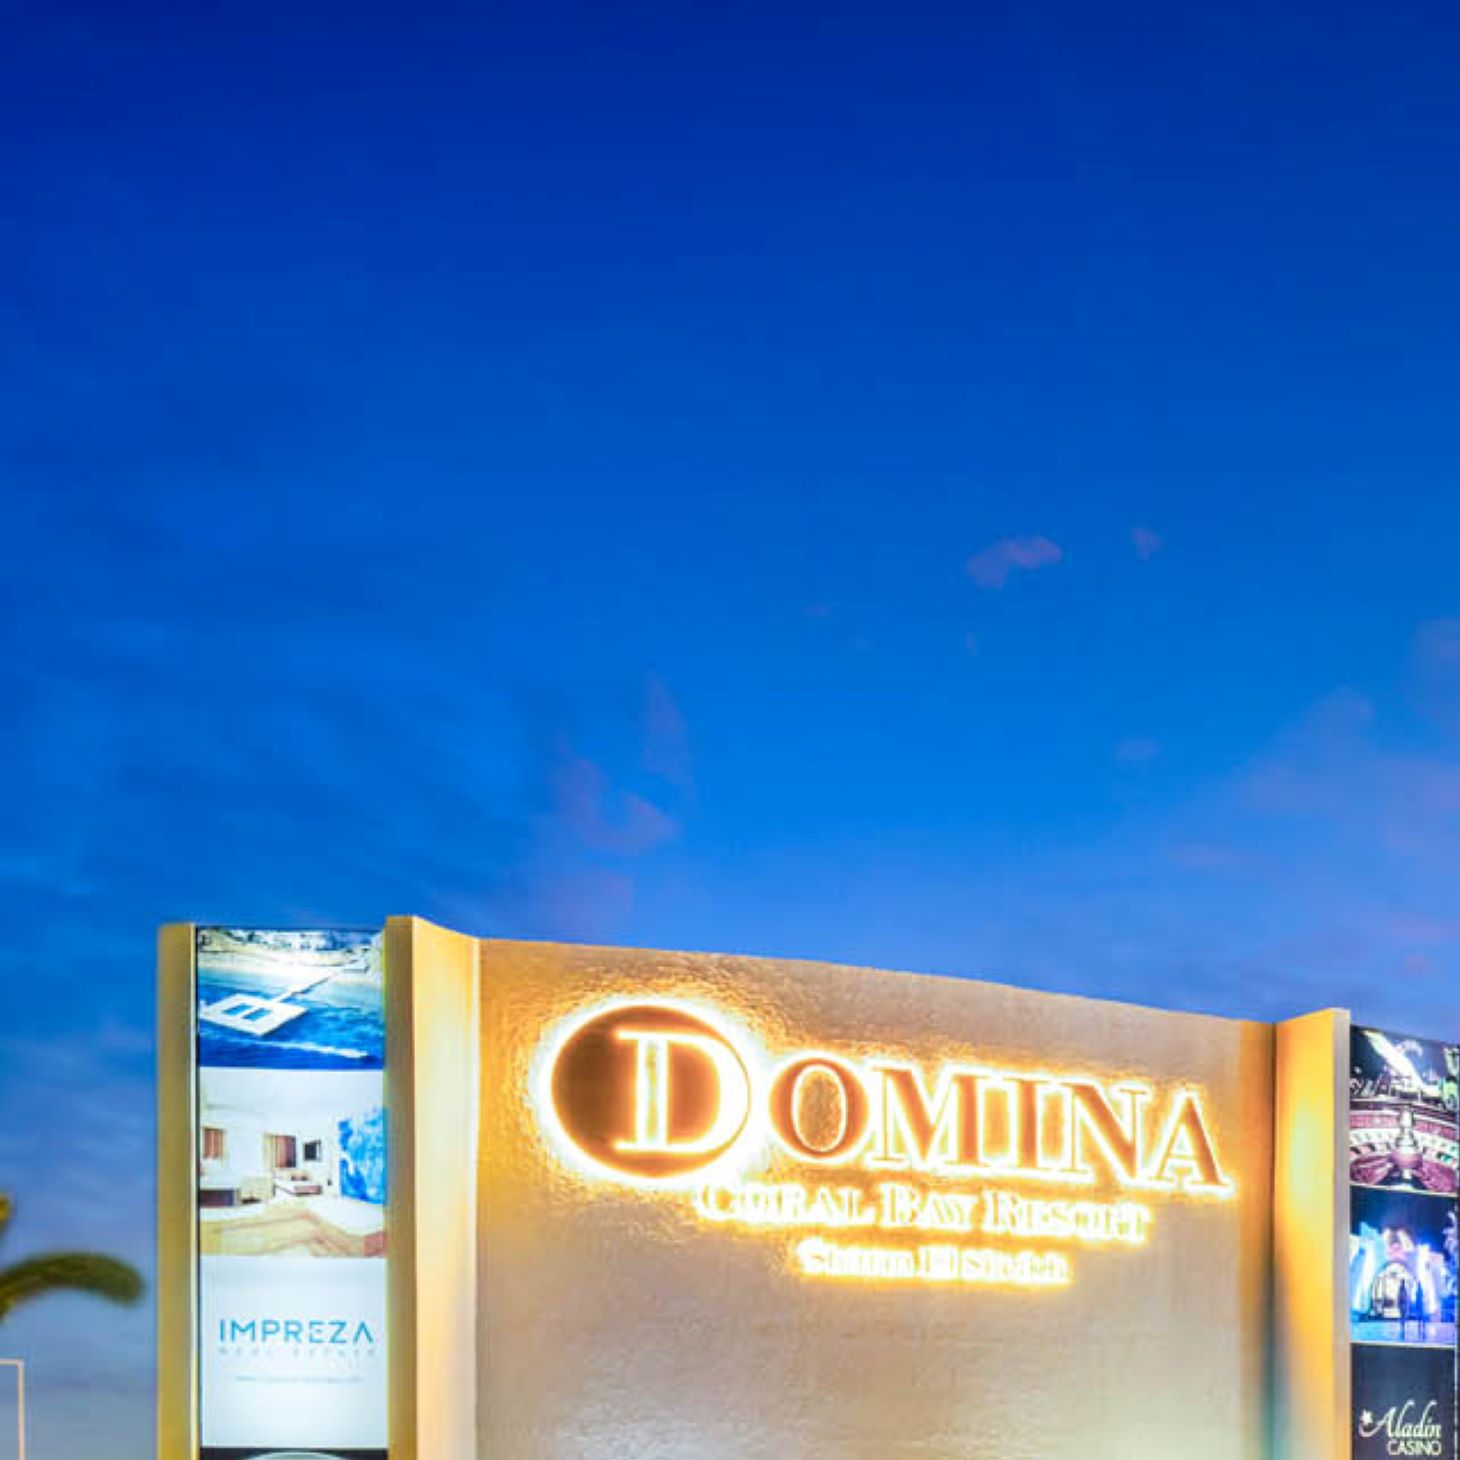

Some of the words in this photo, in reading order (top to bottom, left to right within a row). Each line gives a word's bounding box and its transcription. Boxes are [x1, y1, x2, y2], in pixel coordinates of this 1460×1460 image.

[549, 1002, 1233, 1198] DOMINA
[219, 1318, 375, 1344] IMPREZA
[1386, 1440, 1442, 1456] CASINO
